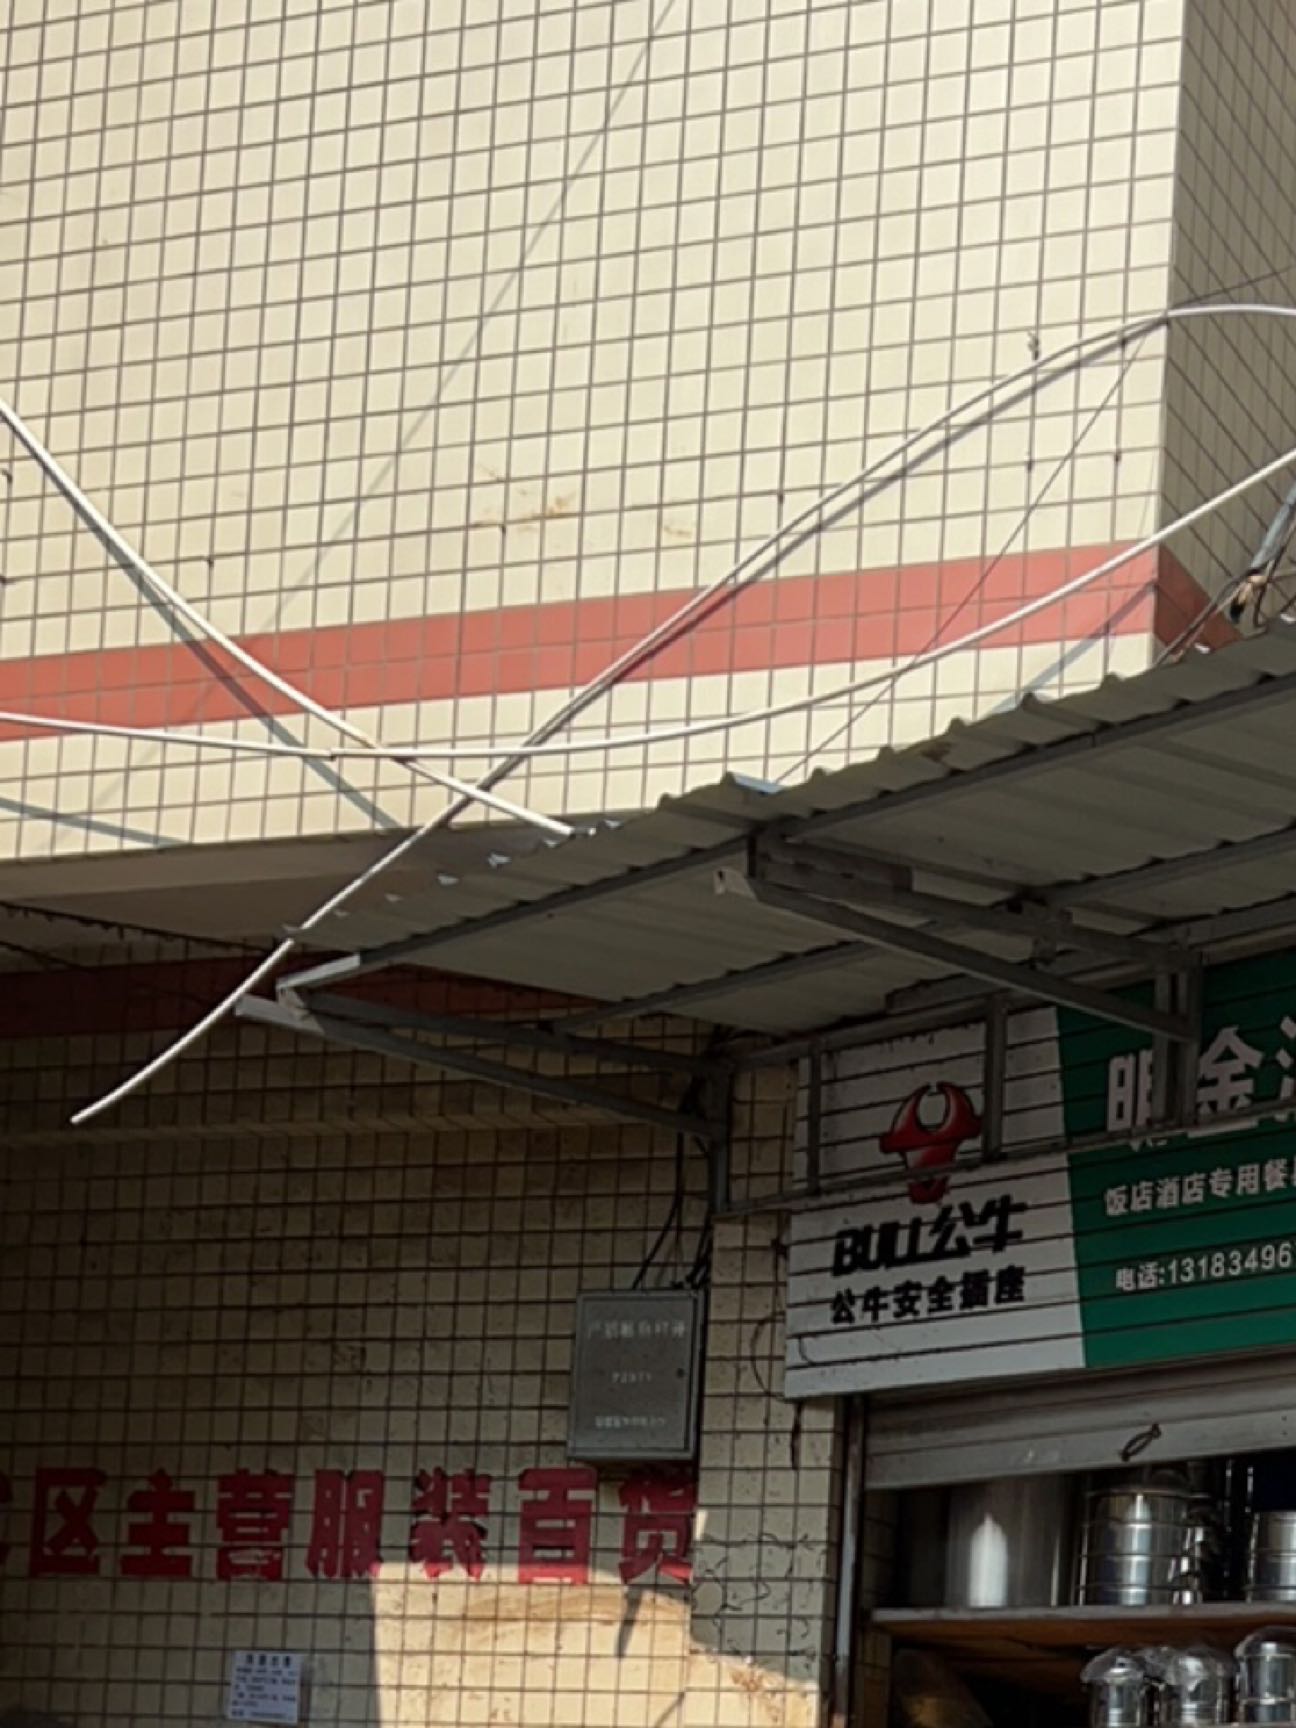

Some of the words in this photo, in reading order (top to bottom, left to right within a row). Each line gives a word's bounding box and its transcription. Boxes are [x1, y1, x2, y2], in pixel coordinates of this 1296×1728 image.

[831, 1264, 1026, 1324] 公牛安全插座
[0, 1466, 699, 1586] 区主营服装百货
